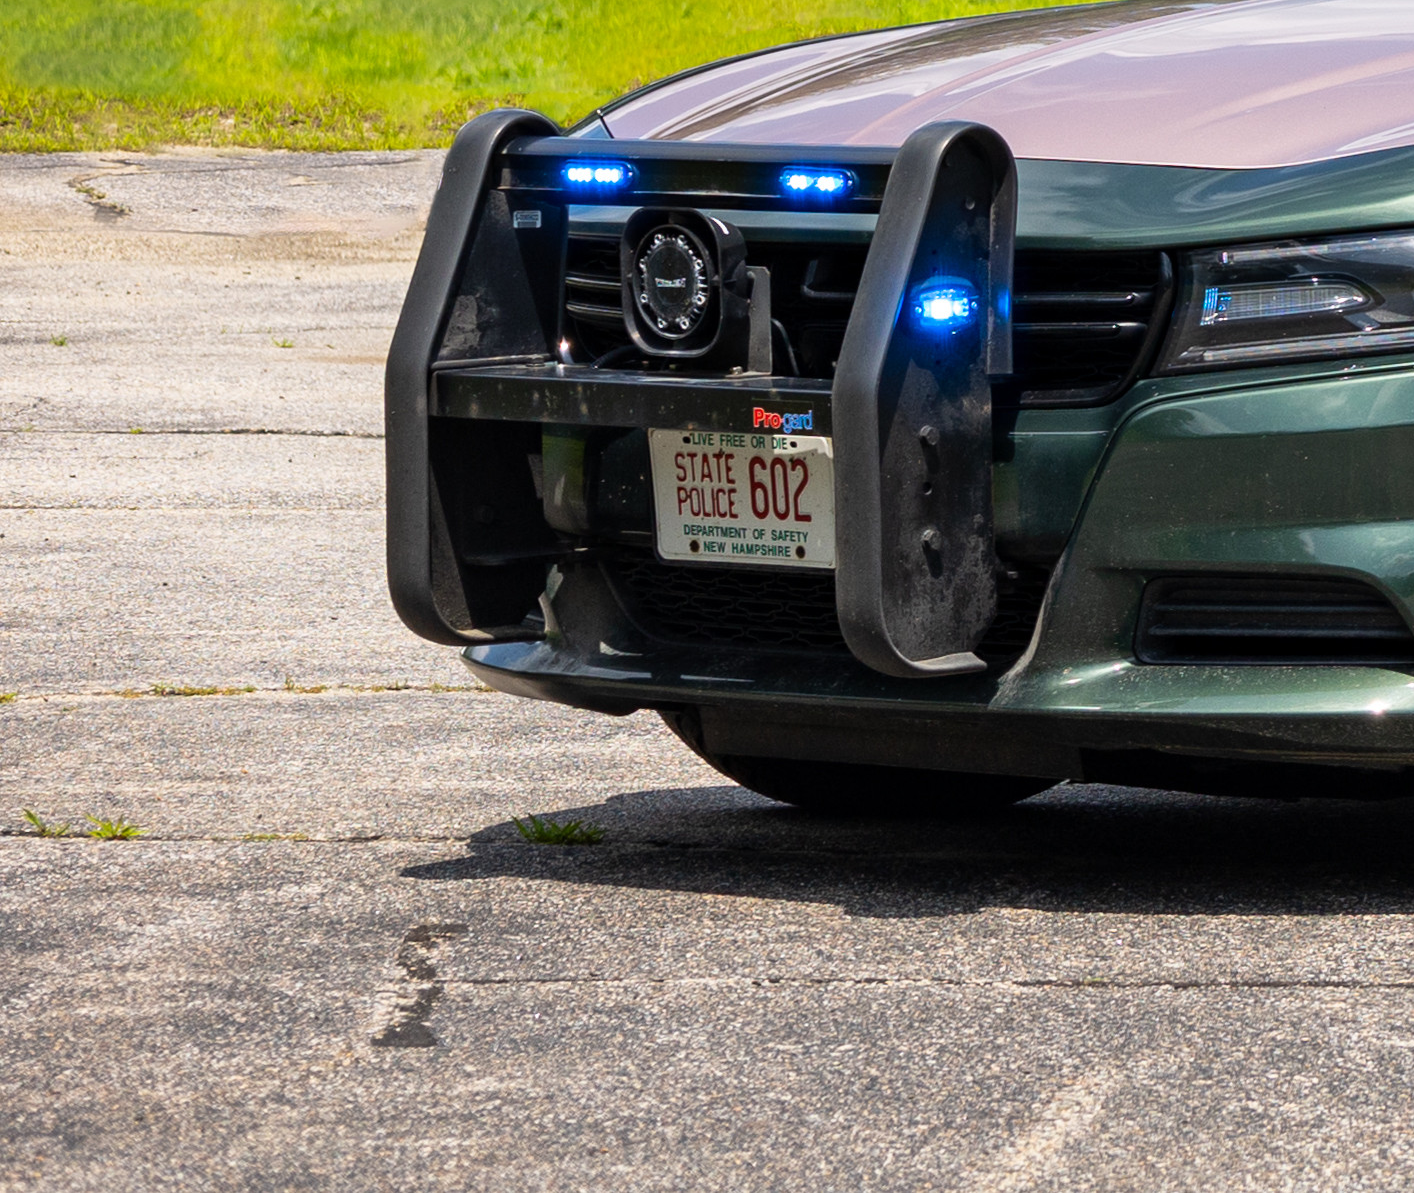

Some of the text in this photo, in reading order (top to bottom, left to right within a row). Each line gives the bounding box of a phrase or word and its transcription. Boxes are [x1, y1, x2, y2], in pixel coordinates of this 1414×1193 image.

[753, 407, 813, 434] Pro-gard
[720, 434, 746, 448] FREE
[751, 436, 766, 449] OR
[772, 437, 788, 450] DIE
[674, 453, 812, 523] STATE 602
[677, 486, 739, 519] POLICE
[683, 524, 809, 543] DEPARTMENT OF SAFETY
[703, 541, 791, 557] NEW HAMPSHIRE
